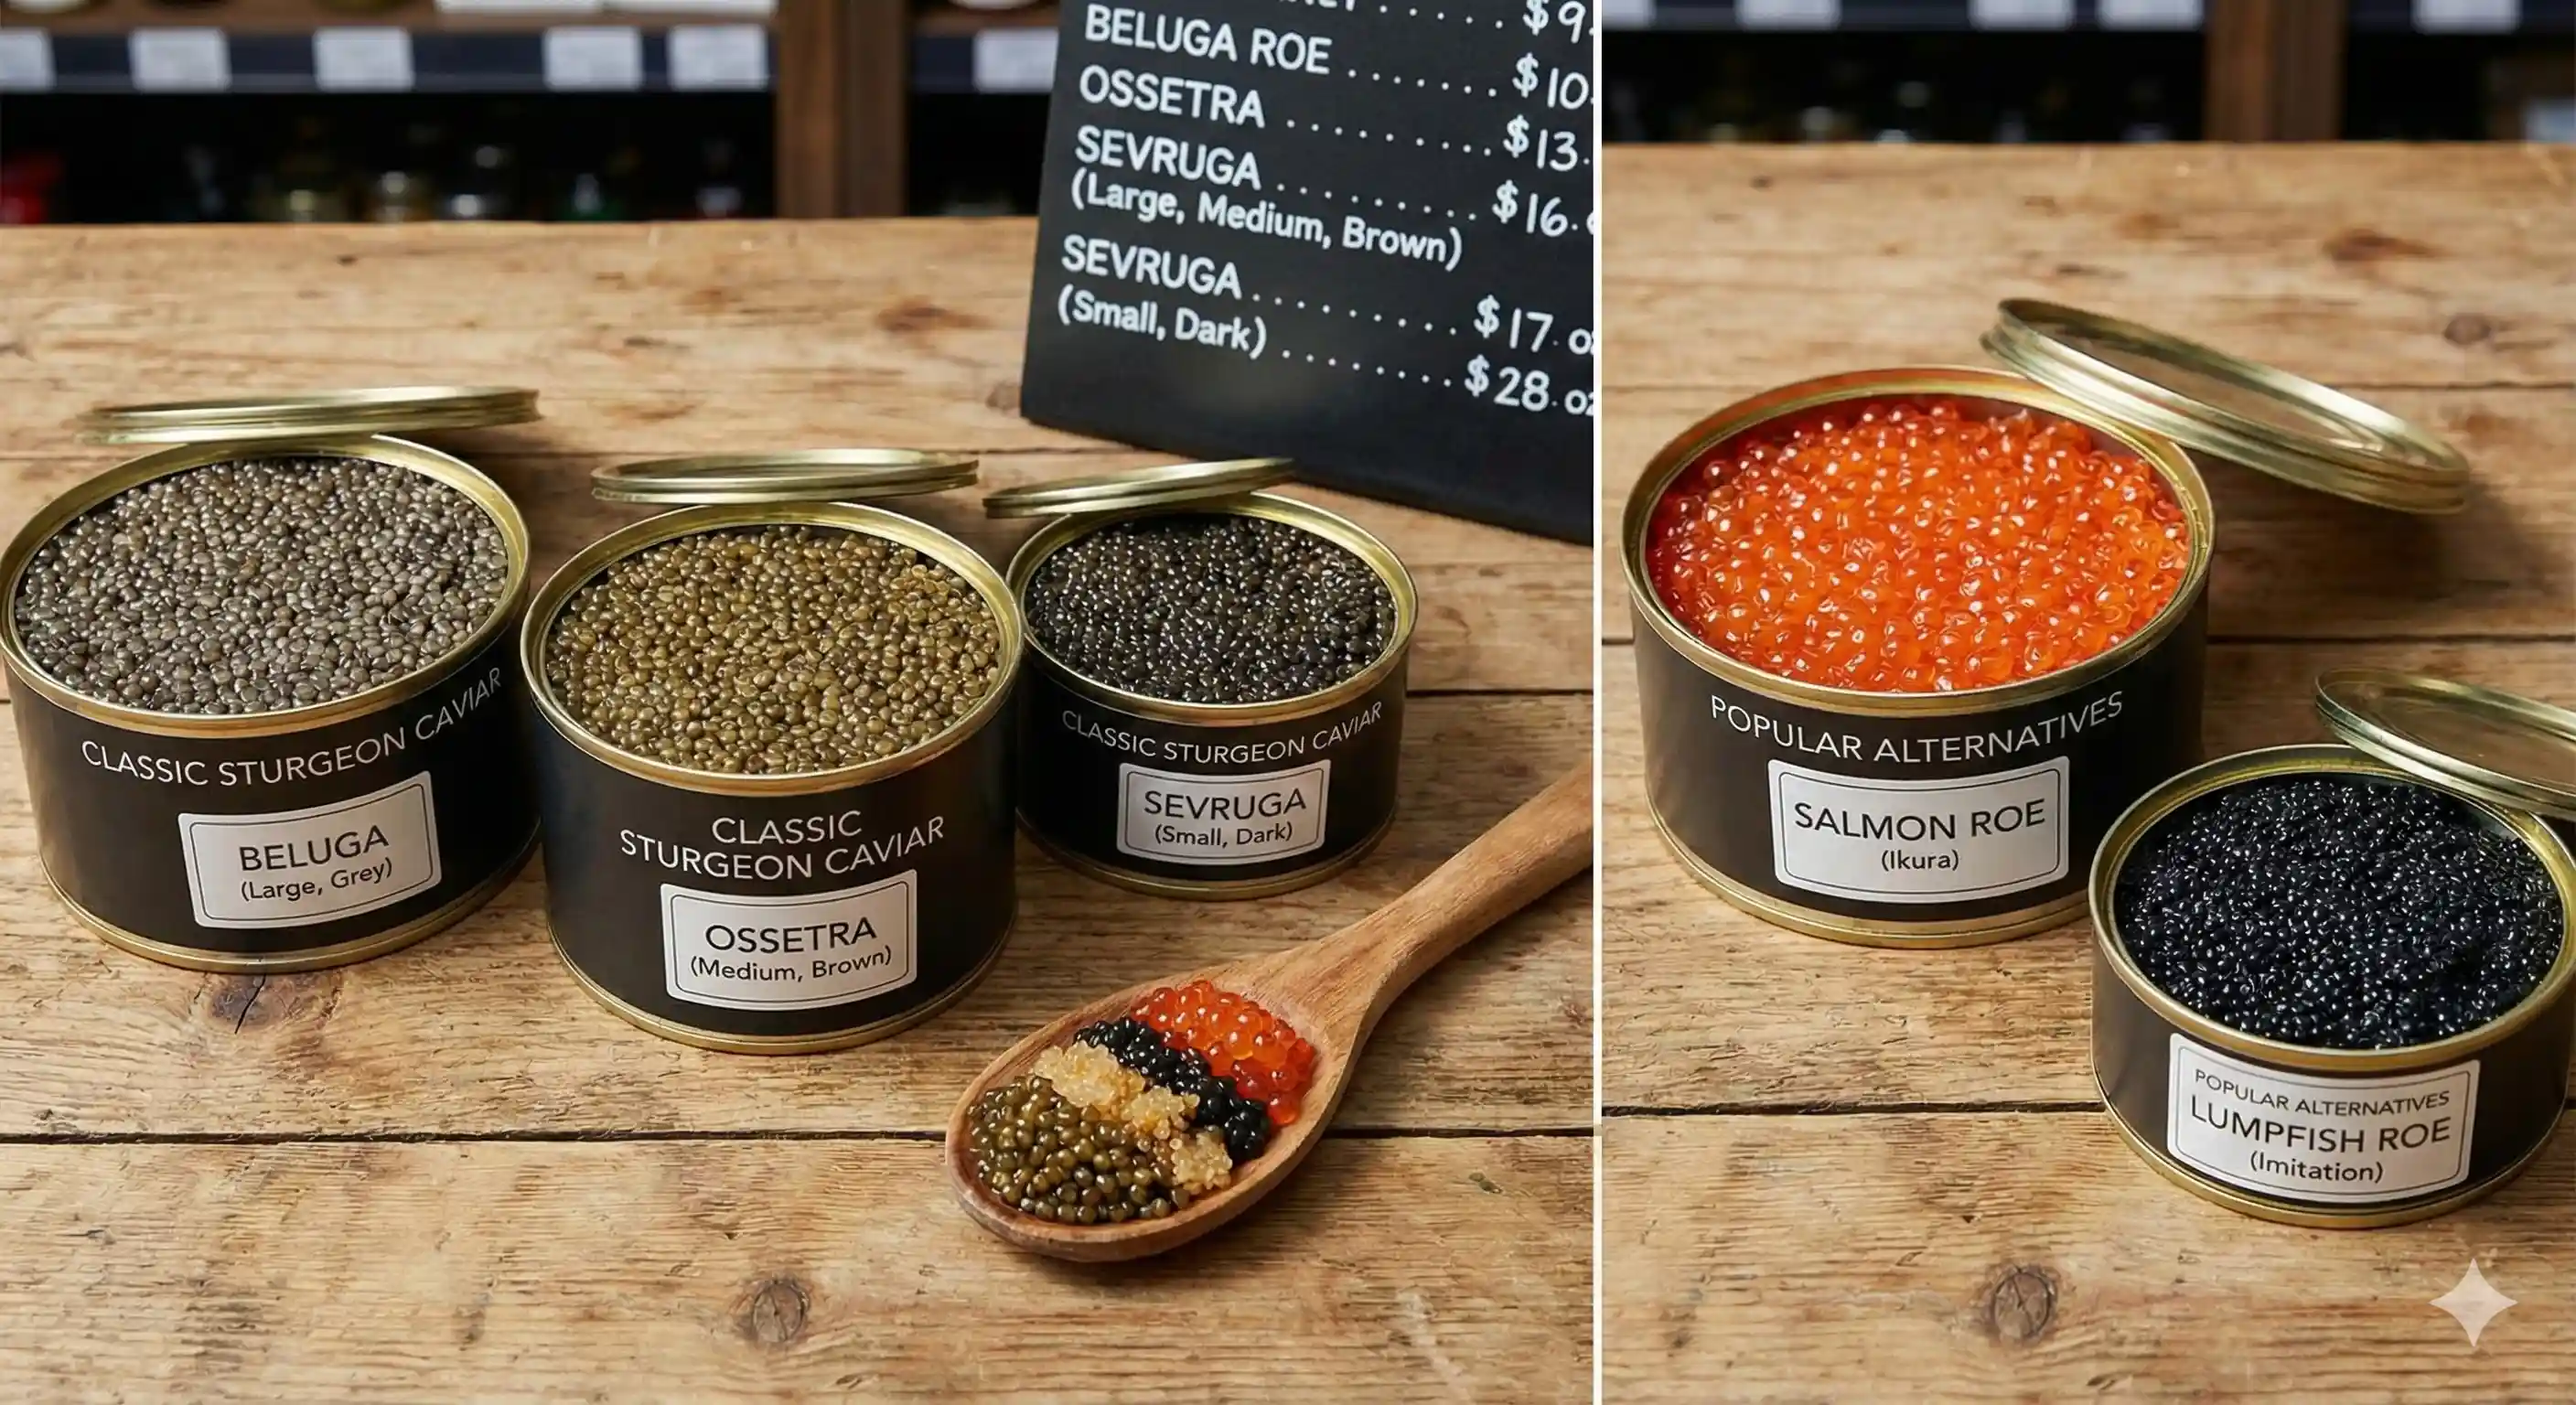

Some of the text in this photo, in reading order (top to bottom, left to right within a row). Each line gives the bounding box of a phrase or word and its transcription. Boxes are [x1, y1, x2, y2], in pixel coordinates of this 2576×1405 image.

[1085, 4, 1238, 62] BELUGA
[1250, 27, 1333, 74] ROE
[1079, 65, 1590, 172] OSSETRA $13.
[1075, 125, 1261, 190] SEVRUGA
[1071, 168, 1464, 272] (Large, Medium, Brown)
[1061, 235, 1242, 300] SEVRUGA
[1057, 284, 1167, 341] (Small,
[1175, 310, 1268, 360] Dark)
[81, 666, 502, 787] CLASSIC STURGEON CAVIAR
[1061, 701, 1384, 764] CLASSIC STURGEON CAVIAR
[1711, 691, 2124, 764] POPULAR ALTERNATIVES
[711, 810, 864, 845] CLASSIC
[1143, 788, 1308, 821] SEVRUGA
[1794, 798, 2046, 842] SALMON ROE
[238, 824, 390, 874] BELUGA
[619, 815, 946, 881] STURGEON CAVIAR
[1154, 821, 1294, 850] (Small, Dark)
[1880, 849, 1960, 872] (Ikura)
[240, 857, 393, 903] (Large, Grey)
[704, 917, 878, 954] OSSETRA
[690, 945, 892, 983] (Medium, Brown)
[2195, 1068, 2451, 1117] POPULAR ALTERNATIVES
[2191, 1095, 2452, 1153] LUMPFISH ROE
[2249, 1150, 2384, 1184] (Imitation)
